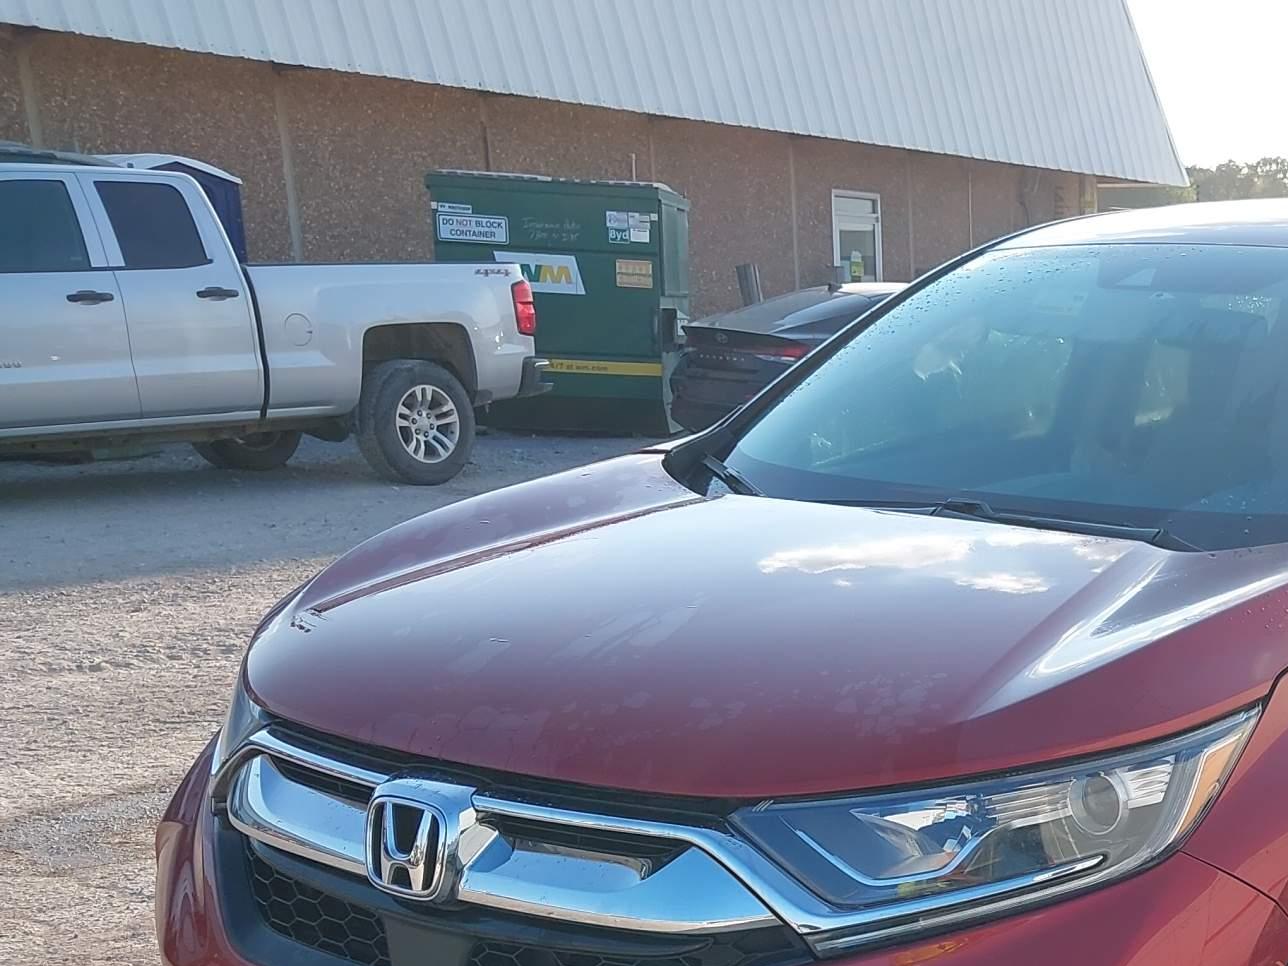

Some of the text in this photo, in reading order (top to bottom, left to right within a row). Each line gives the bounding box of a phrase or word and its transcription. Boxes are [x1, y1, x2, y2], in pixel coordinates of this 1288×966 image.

[442, 218, 503, 229] DO NOT BLOCK
[450, 229, 496, 239] CONTAINER
